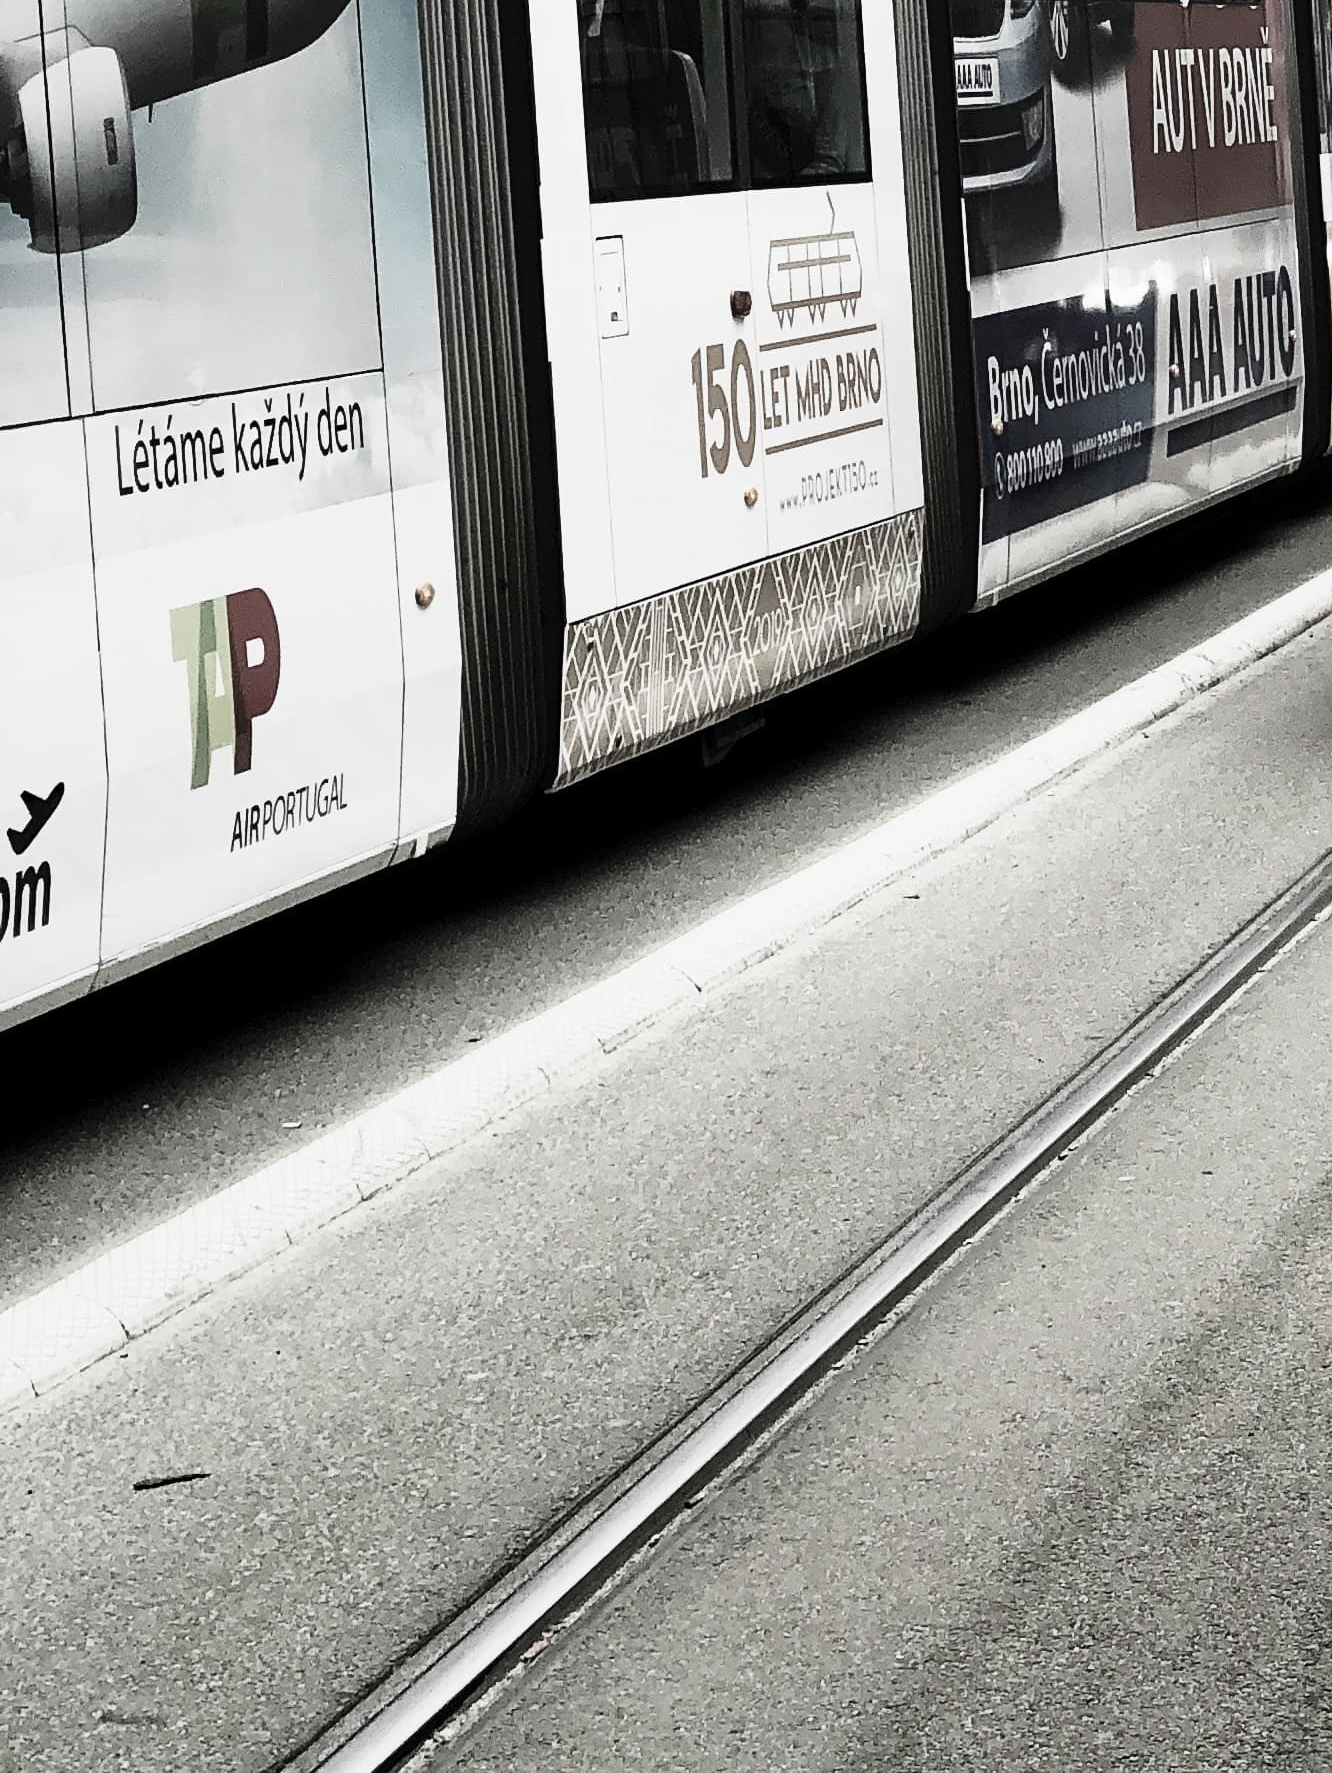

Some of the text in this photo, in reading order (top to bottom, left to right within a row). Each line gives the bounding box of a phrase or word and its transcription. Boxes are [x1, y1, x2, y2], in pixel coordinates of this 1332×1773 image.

[1152, 26, 1278, 155] AUT V BRNĚ
[987, 321, 1146, 426] Brno, Černovická 38
[1168, 265, 1295, 416] AAA AUTO
[114, 386, 365, 497] Létáme každý den
[690, 338, 882, 478] 150 LET MHD BRNO
[168, 587, 281, 791] TAP
[752, 607, 782, 657] 2019
